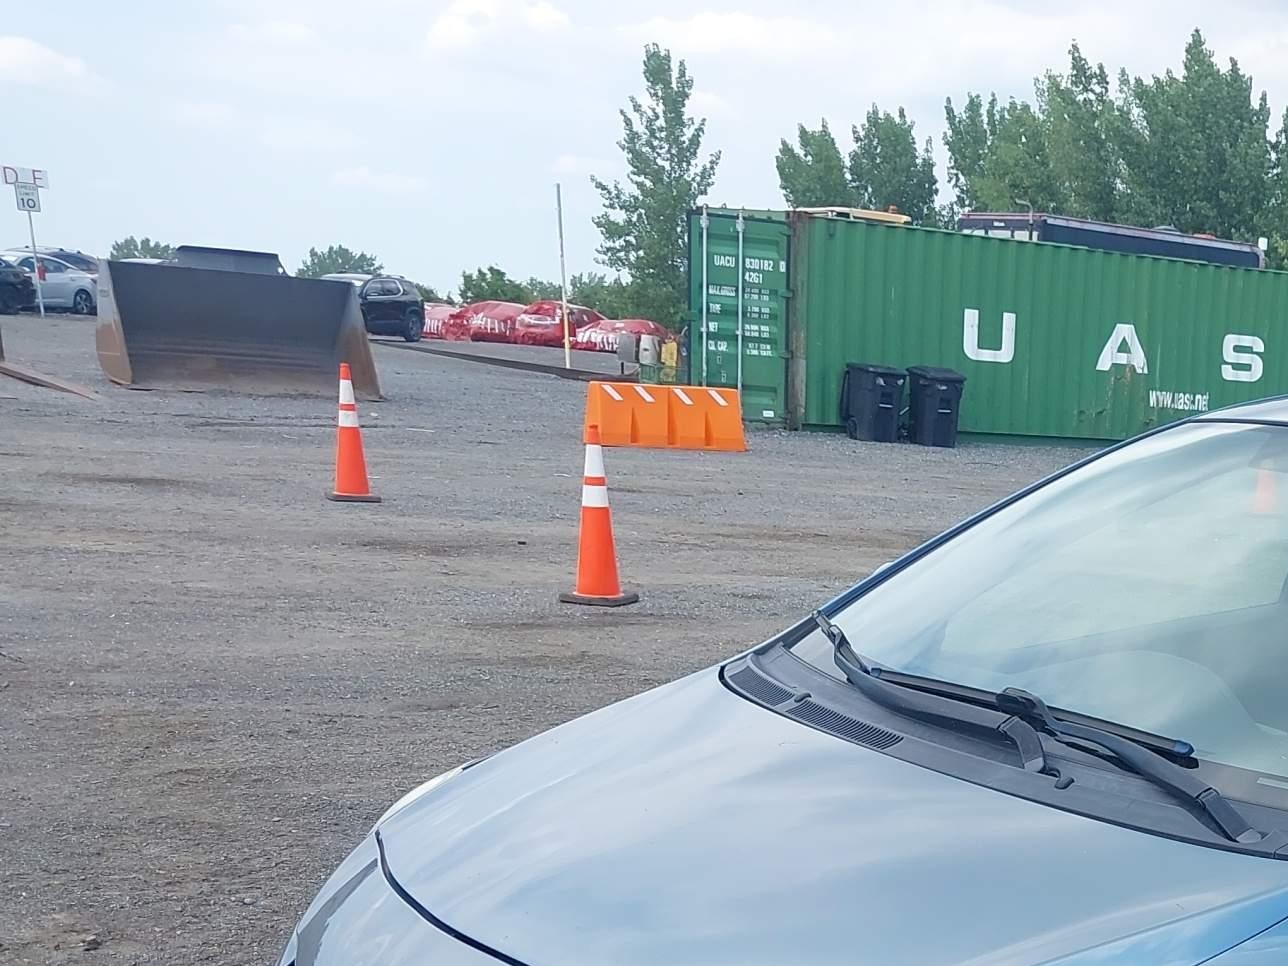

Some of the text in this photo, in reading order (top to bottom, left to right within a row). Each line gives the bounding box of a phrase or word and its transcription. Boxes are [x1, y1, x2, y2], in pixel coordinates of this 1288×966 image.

[3, 166, 18, 184] D
[20, 197, 36, 209] 10
[714, 254, 736, 268] UACU
[744, 271, 763, 284] 42G1
